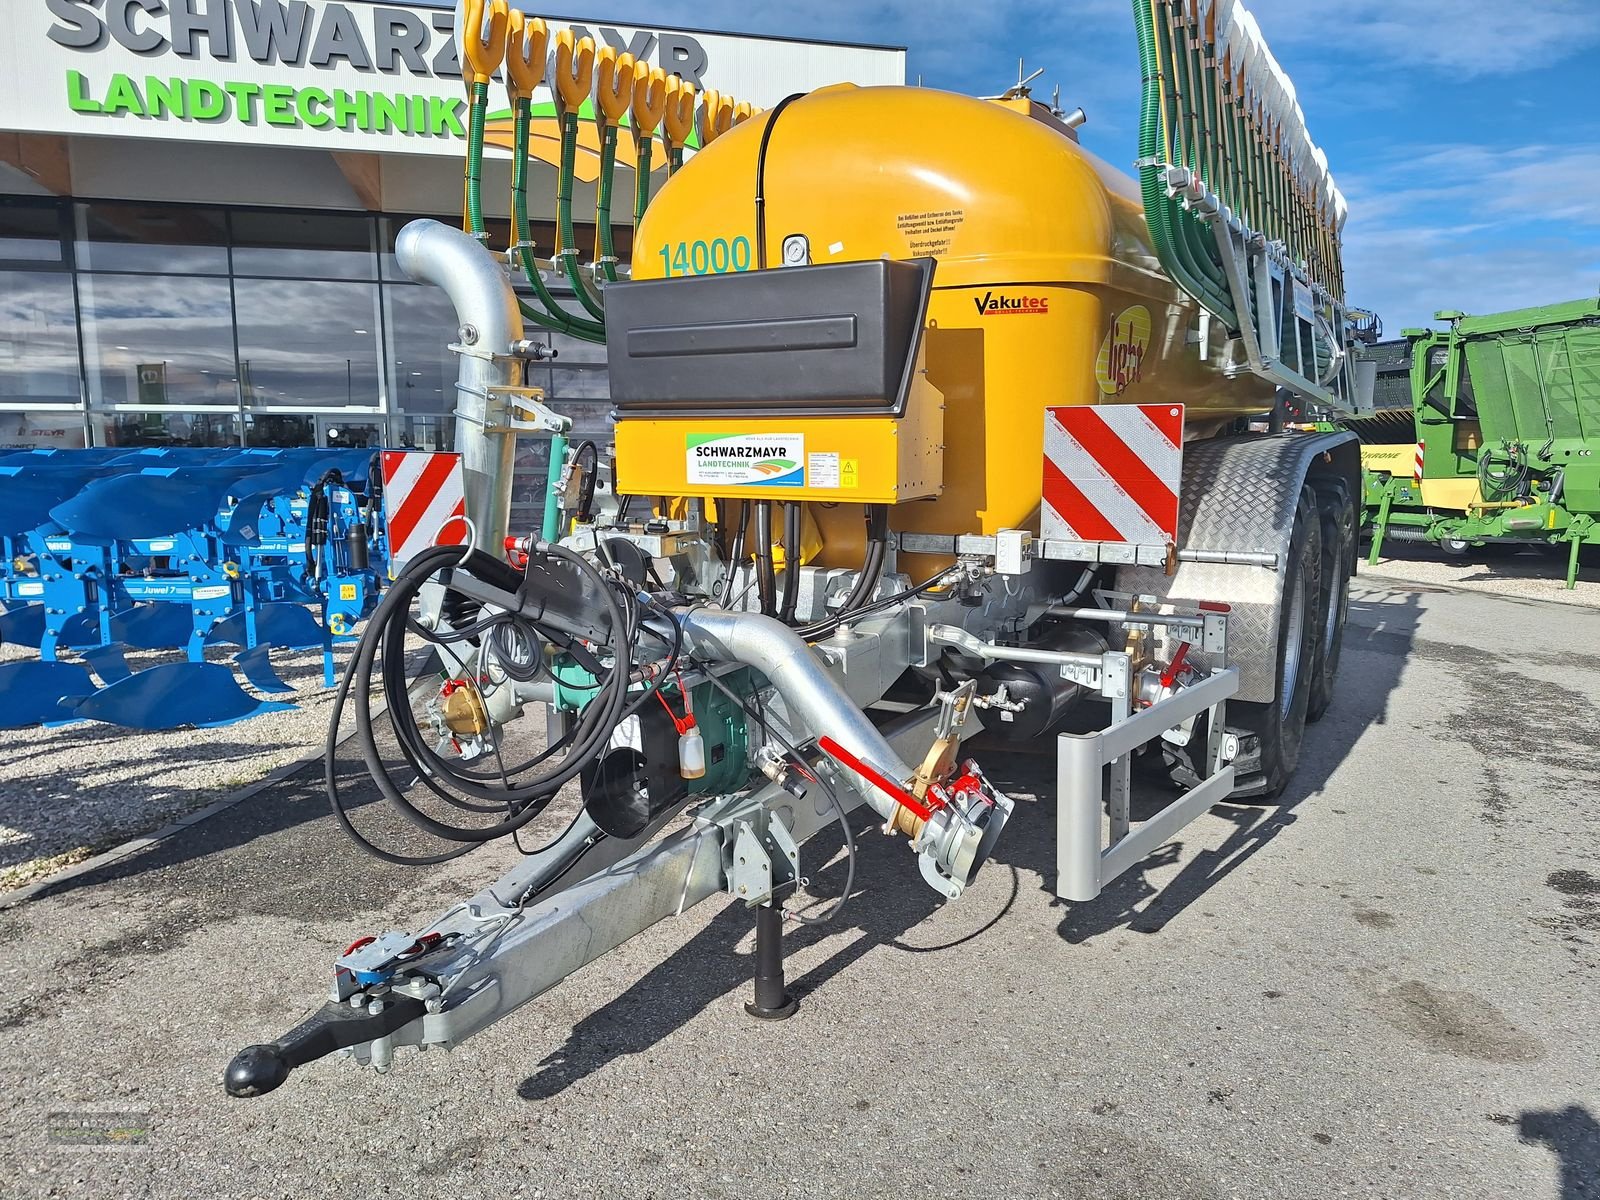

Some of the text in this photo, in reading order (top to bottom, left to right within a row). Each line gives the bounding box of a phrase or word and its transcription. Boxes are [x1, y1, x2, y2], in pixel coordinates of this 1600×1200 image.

[66, 69, 467, 137] LANDTECHNIK
[659, 236, 751, 278] 14000
[974, 292, 1048, 315] Vakutec
[1107, 312, 1143, 396] light
[696, 446, 787, 458] SCHWARZMAYR
[698, 460, 750, 468] LANDTECHNIK
[143, 586, 177, 594] Juwel 7
